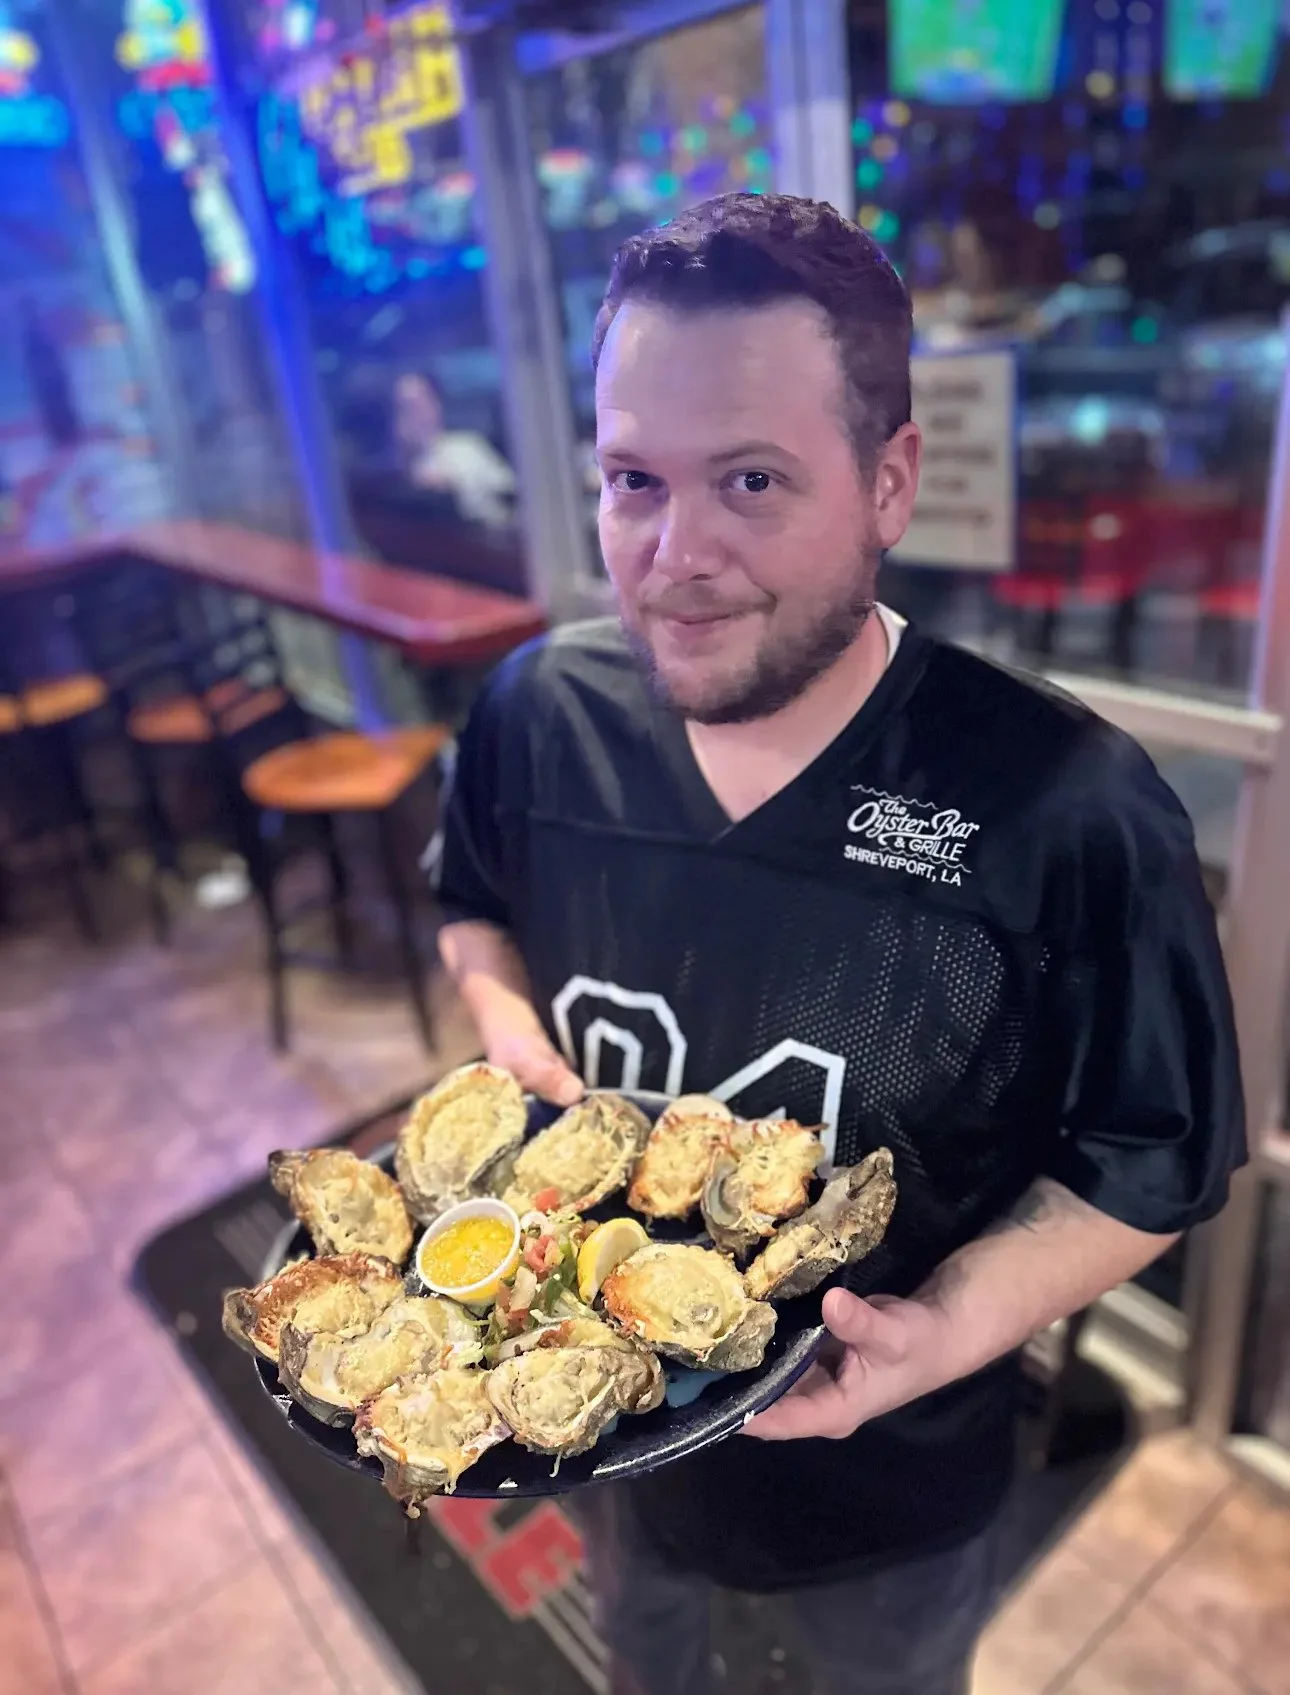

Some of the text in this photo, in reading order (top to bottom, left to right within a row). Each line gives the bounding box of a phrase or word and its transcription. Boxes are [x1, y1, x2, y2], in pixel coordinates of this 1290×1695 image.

[847, 802, 980, 840] Oyster Bar
[879, 799, 907, 815] The
[894, 837, 967, 862] & GRILLE
[843, 844, 962, 887] SHREVEPORT, LA
